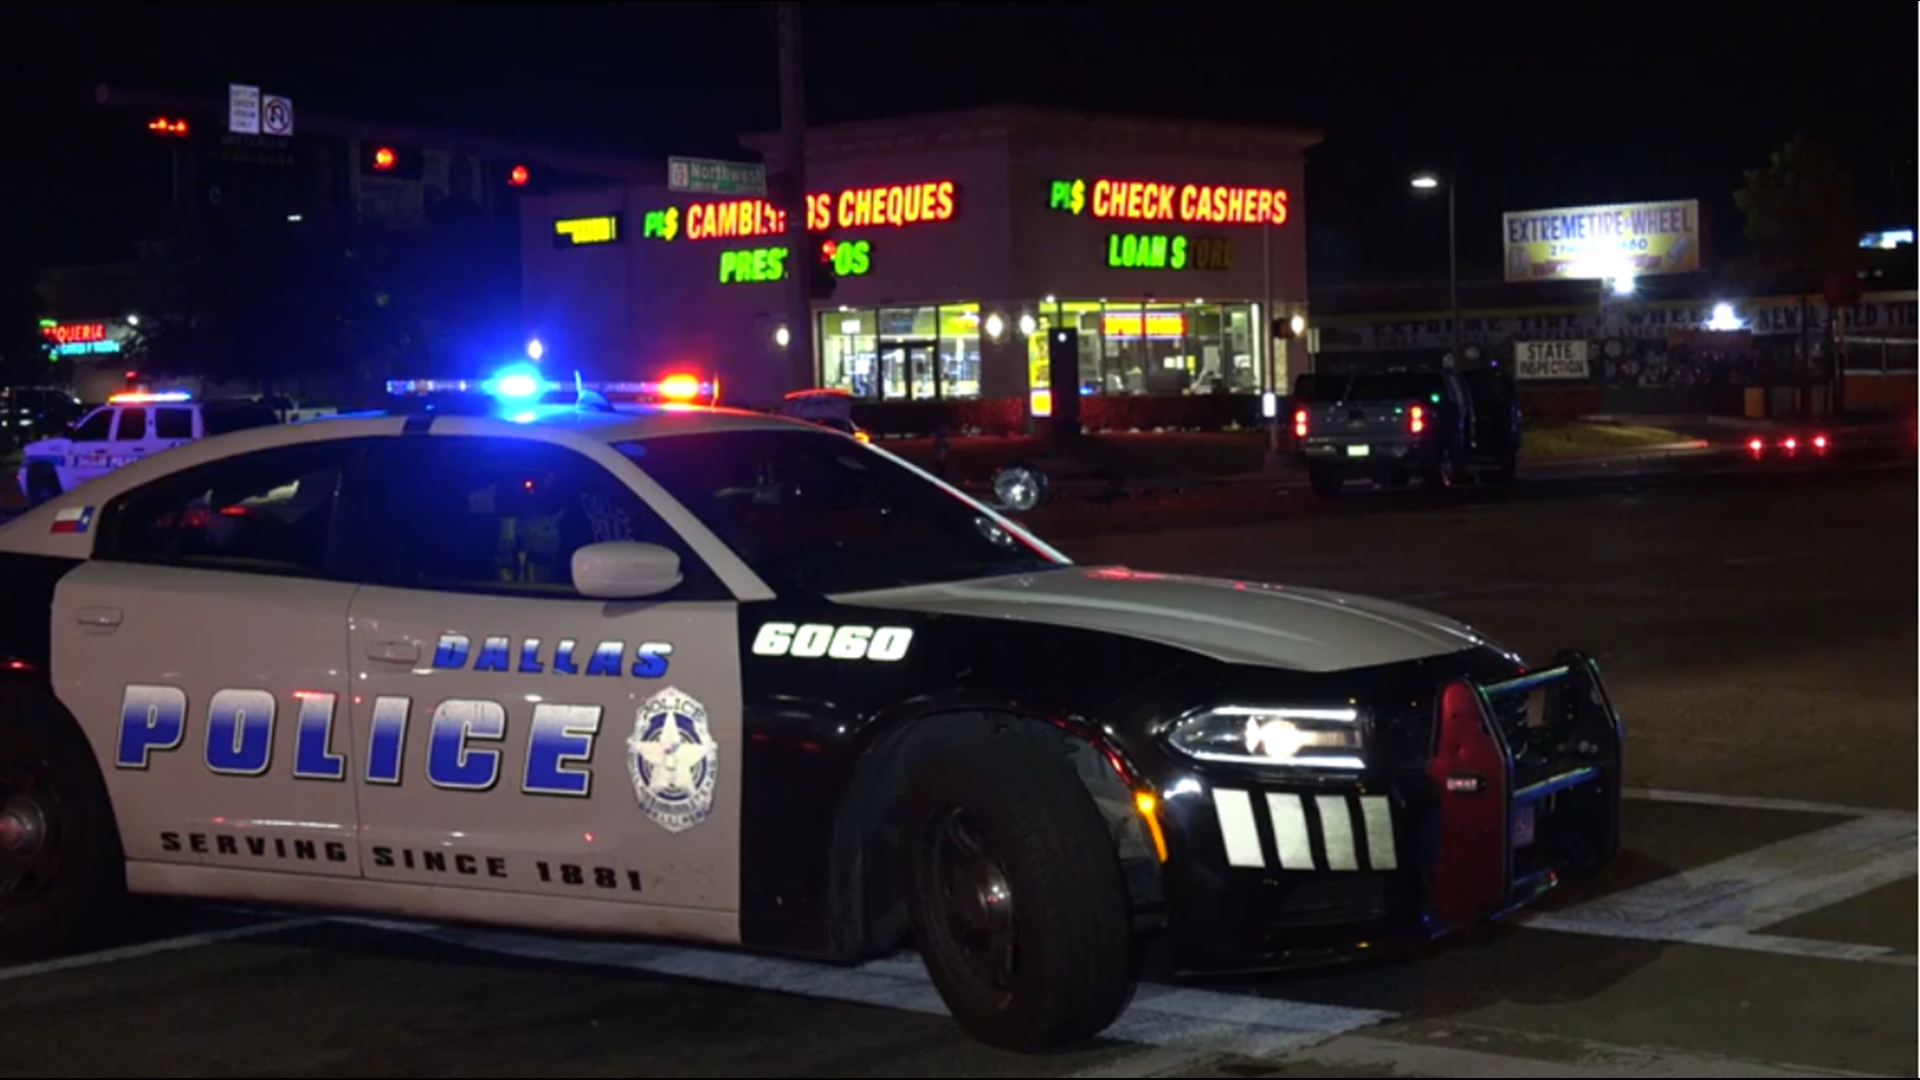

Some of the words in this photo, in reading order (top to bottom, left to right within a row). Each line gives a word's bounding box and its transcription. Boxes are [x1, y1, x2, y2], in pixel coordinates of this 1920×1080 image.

[691, 163, 762, 182] Northwest
[686, 193, 832, 239] CAMBIS
[838, 180, 954, 227] CHEQUES
[1092, 180, 1176, 220] CHECK
[1179, 184, 1288, 225] CASHERS
[1508, 214, 1585, 244] EXTREME
[1631, 208, 1692, 236] WHEEL
[719, 240, 870, 284] PRESOS
[1108, 233, 1167, 269] LOAN
[1170, 234, 1234, 271] STORE
[1758, 305, 1798, 330] NEW
[1519, 360, 1584, 375] INSPECTION
[1527, 344, 1573, 360] STATE
[431, 633, 674, 679] DALLAS
[751, 621, 914, 662] 6060
[641, 697, 706, 720] POLICE
[114, 684, 604, 798] POLICE
[162, 831, 347, 863] SERVING
[373, 846, 509, 879] SINCE
[537, 860, 643, 892] 1881
